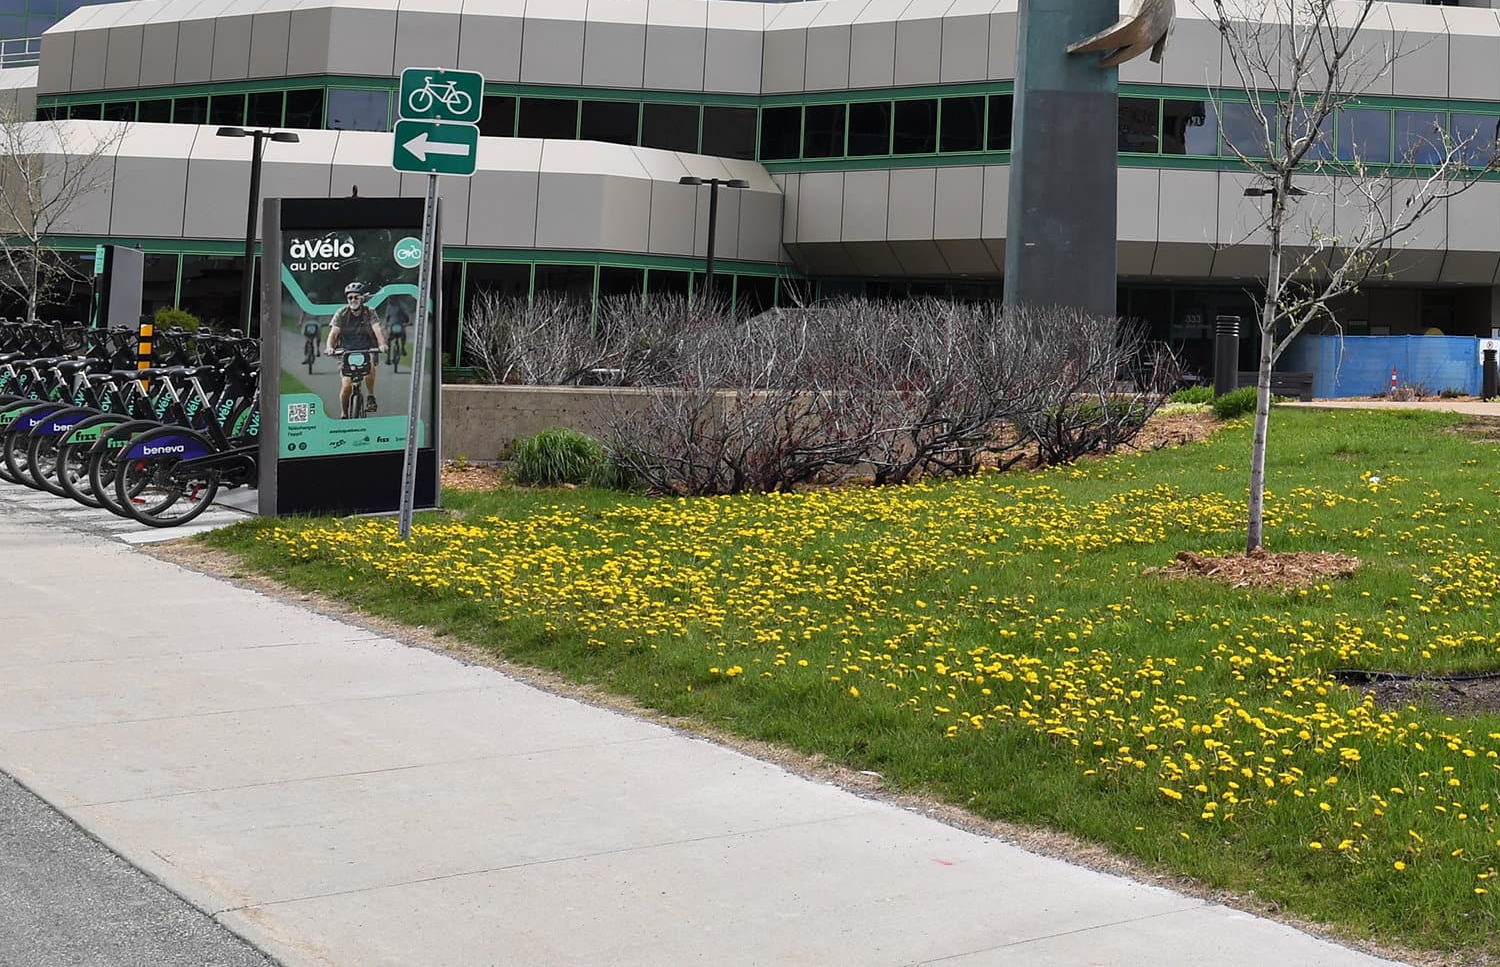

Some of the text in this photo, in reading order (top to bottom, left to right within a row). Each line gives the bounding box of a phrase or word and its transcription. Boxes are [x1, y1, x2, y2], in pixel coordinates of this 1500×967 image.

[290, 238, 355, 258] àVélo
[290, 261, 340, 273] au parc
[143, 445, 185, 455] beneva
